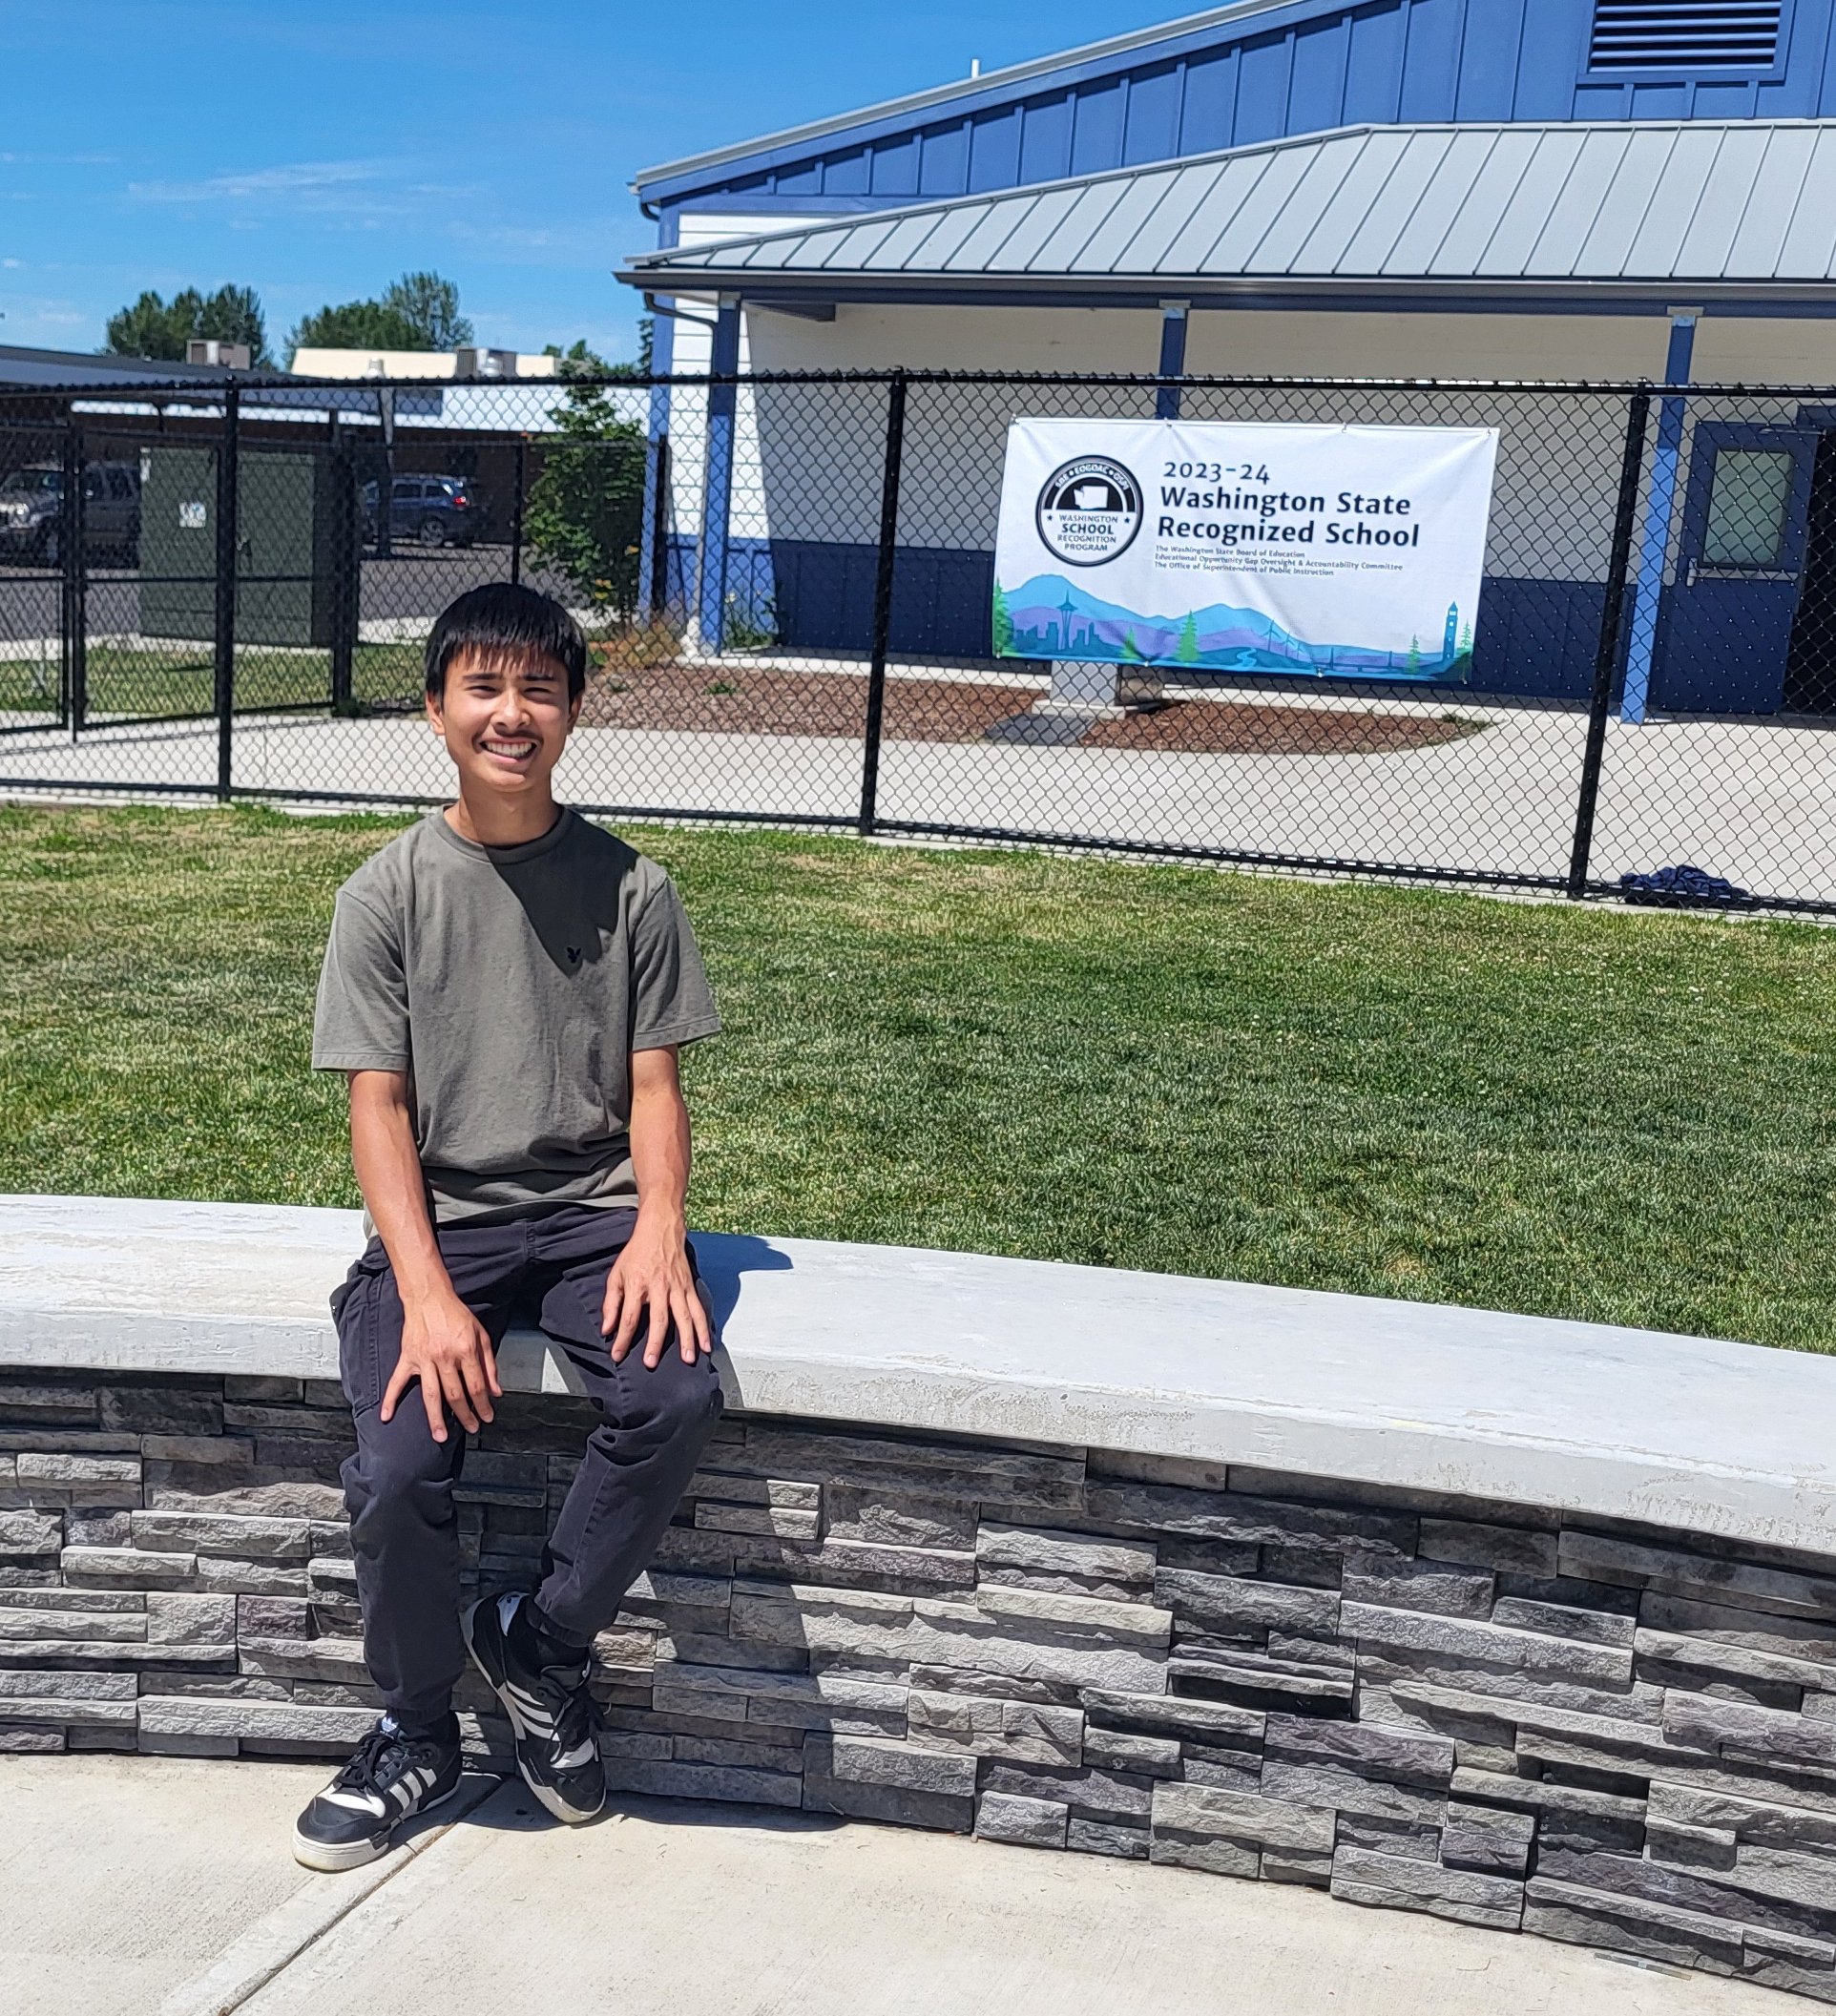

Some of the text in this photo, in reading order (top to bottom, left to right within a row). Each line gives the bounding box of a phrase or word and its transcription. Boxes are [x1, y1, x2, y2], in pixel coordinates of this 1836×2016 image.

[1163, 462, 1270, 485] 2023-24
[1160, 486, 1410, 517] Washington State
[1059, 514, 1117, 523] WASHINGTON
[1062, 524, 1114, 534] SCHOOL
[1158, 516, 1419, 547] Recognized School
[1057, 534, 1116, 543] RECOGNITION
[1171, 546, 1213, 554] Washington
[1361, 562, 1403, 571] Committee
